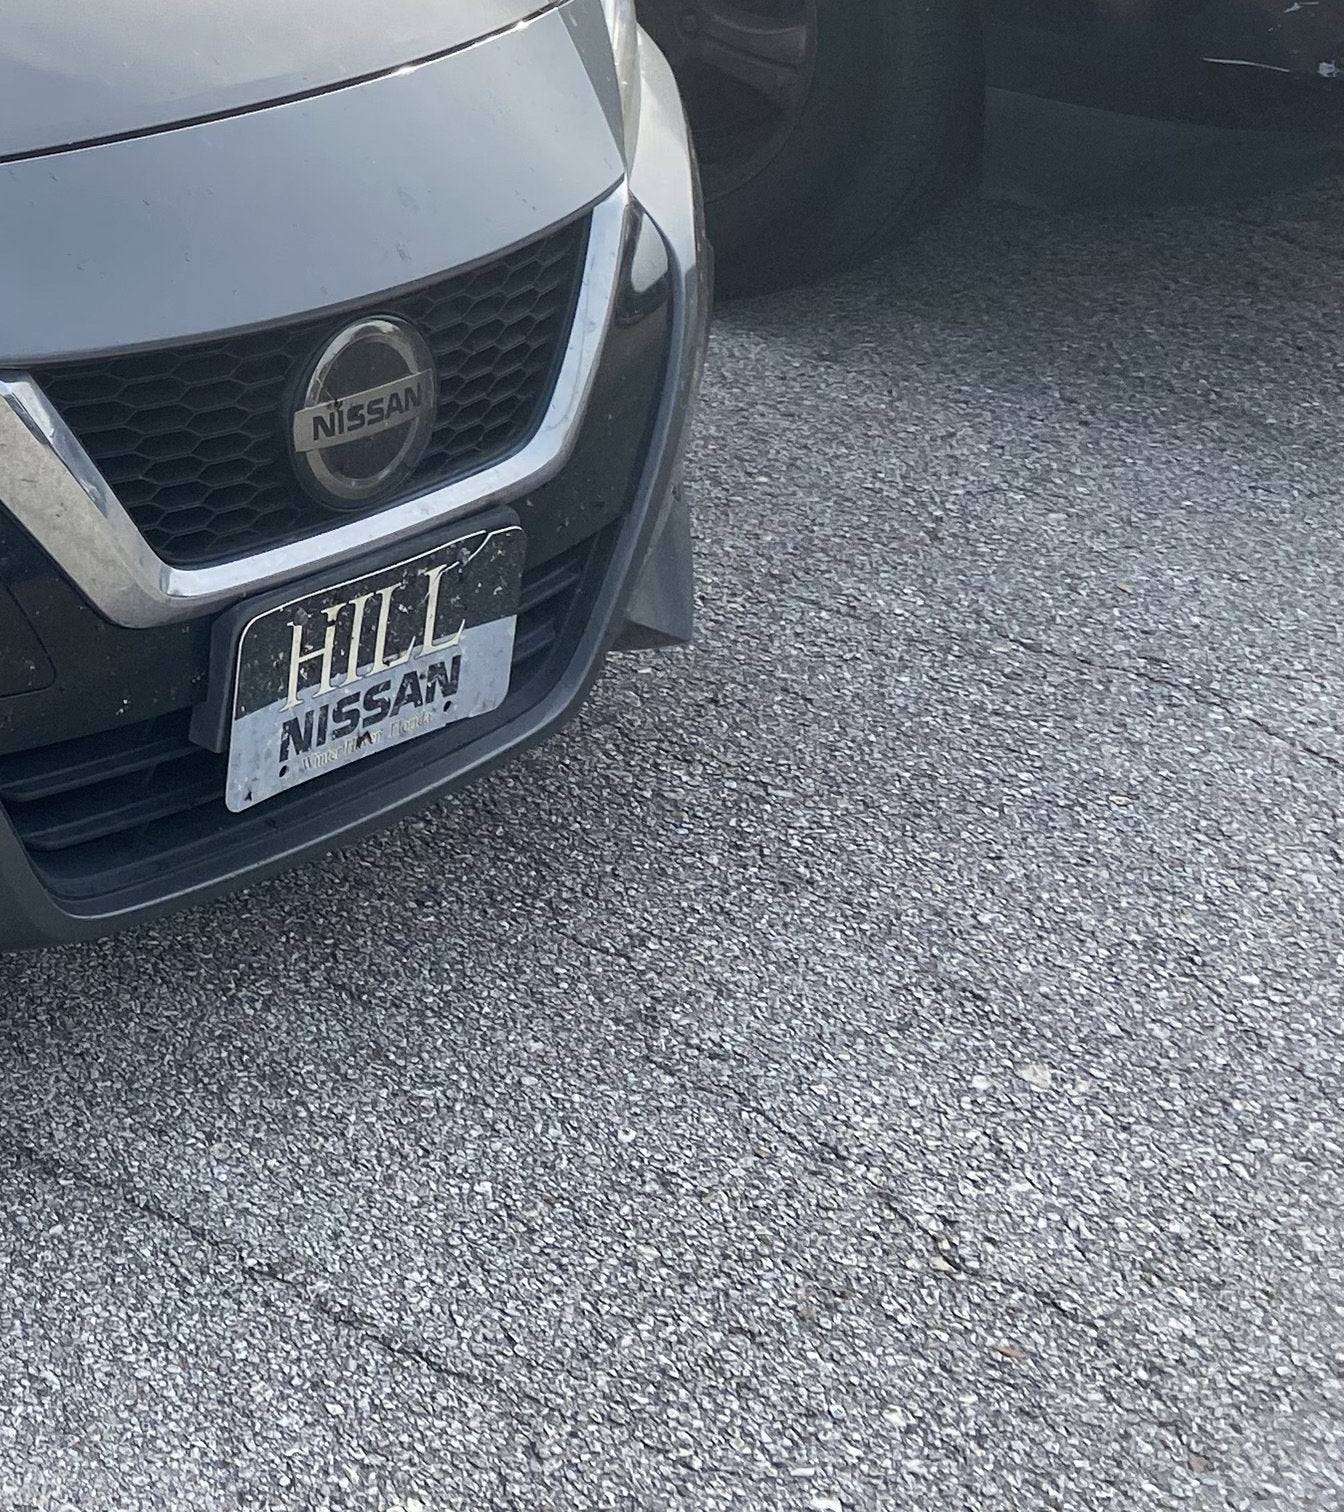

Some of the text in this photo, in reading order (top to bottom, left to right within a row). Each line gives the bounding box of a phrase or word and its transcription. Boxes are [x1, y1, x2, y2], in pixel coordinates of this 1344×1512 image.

[312, 382, 422, 441] NISSAN
[279, 563, 466, 712] HILL
[279, 655, 462, 763] NISSAN
